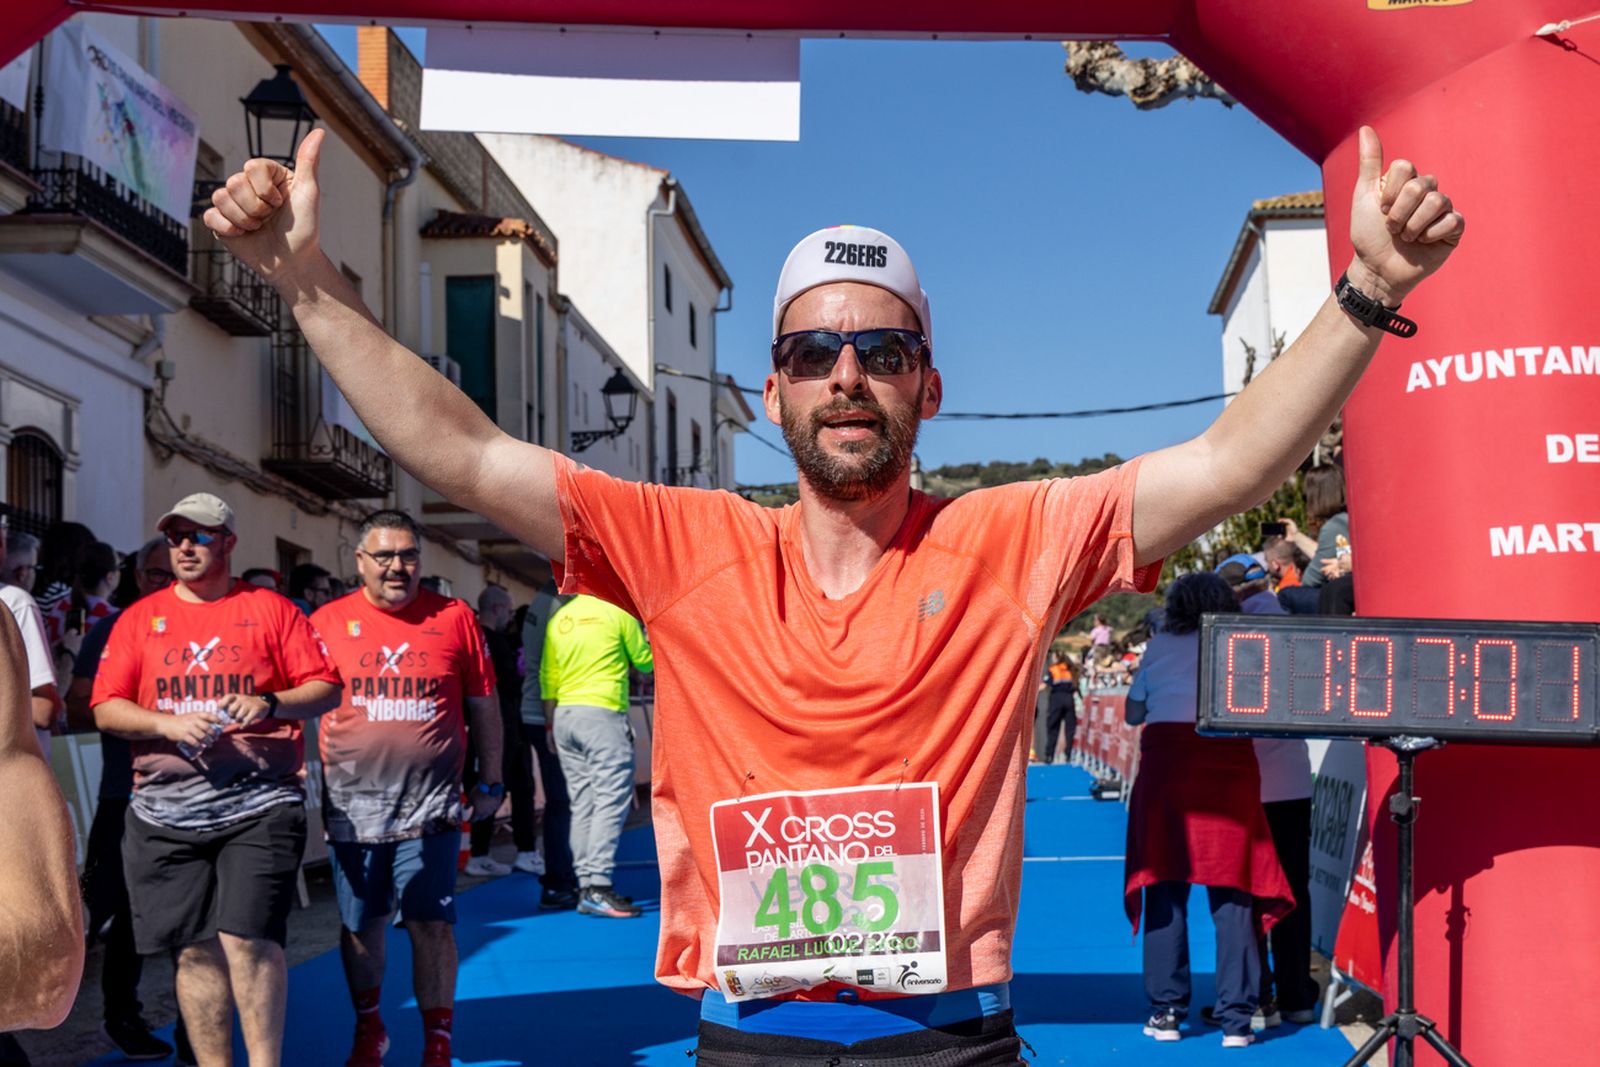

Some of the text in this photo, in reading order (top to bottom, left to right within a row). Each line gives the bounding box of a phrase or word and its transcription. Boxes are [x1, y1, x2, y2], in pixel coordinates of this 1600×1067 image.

[824, 241, 888, 268] 226ERS
[1406, 346, 1600, 393] AYUNTAM
[1546, 434, 1600, 463] DE
[164, 645, 242, 667] CROSS
[360, 651, 428, 668] CROSS
[156, 673, 256, 701] PANTANO
[351, 676, 440, 698] PANTANO
[366, 694, 437, 722] VÍBORAS
[741, 807, 776, 848] X
[780, 810, 896, 843] CROSS
[745, 841, 897, 876] PANTANO DEL
[755, 861, 900, 939] 485
[737, 943, 800, 961] RAFAEL
